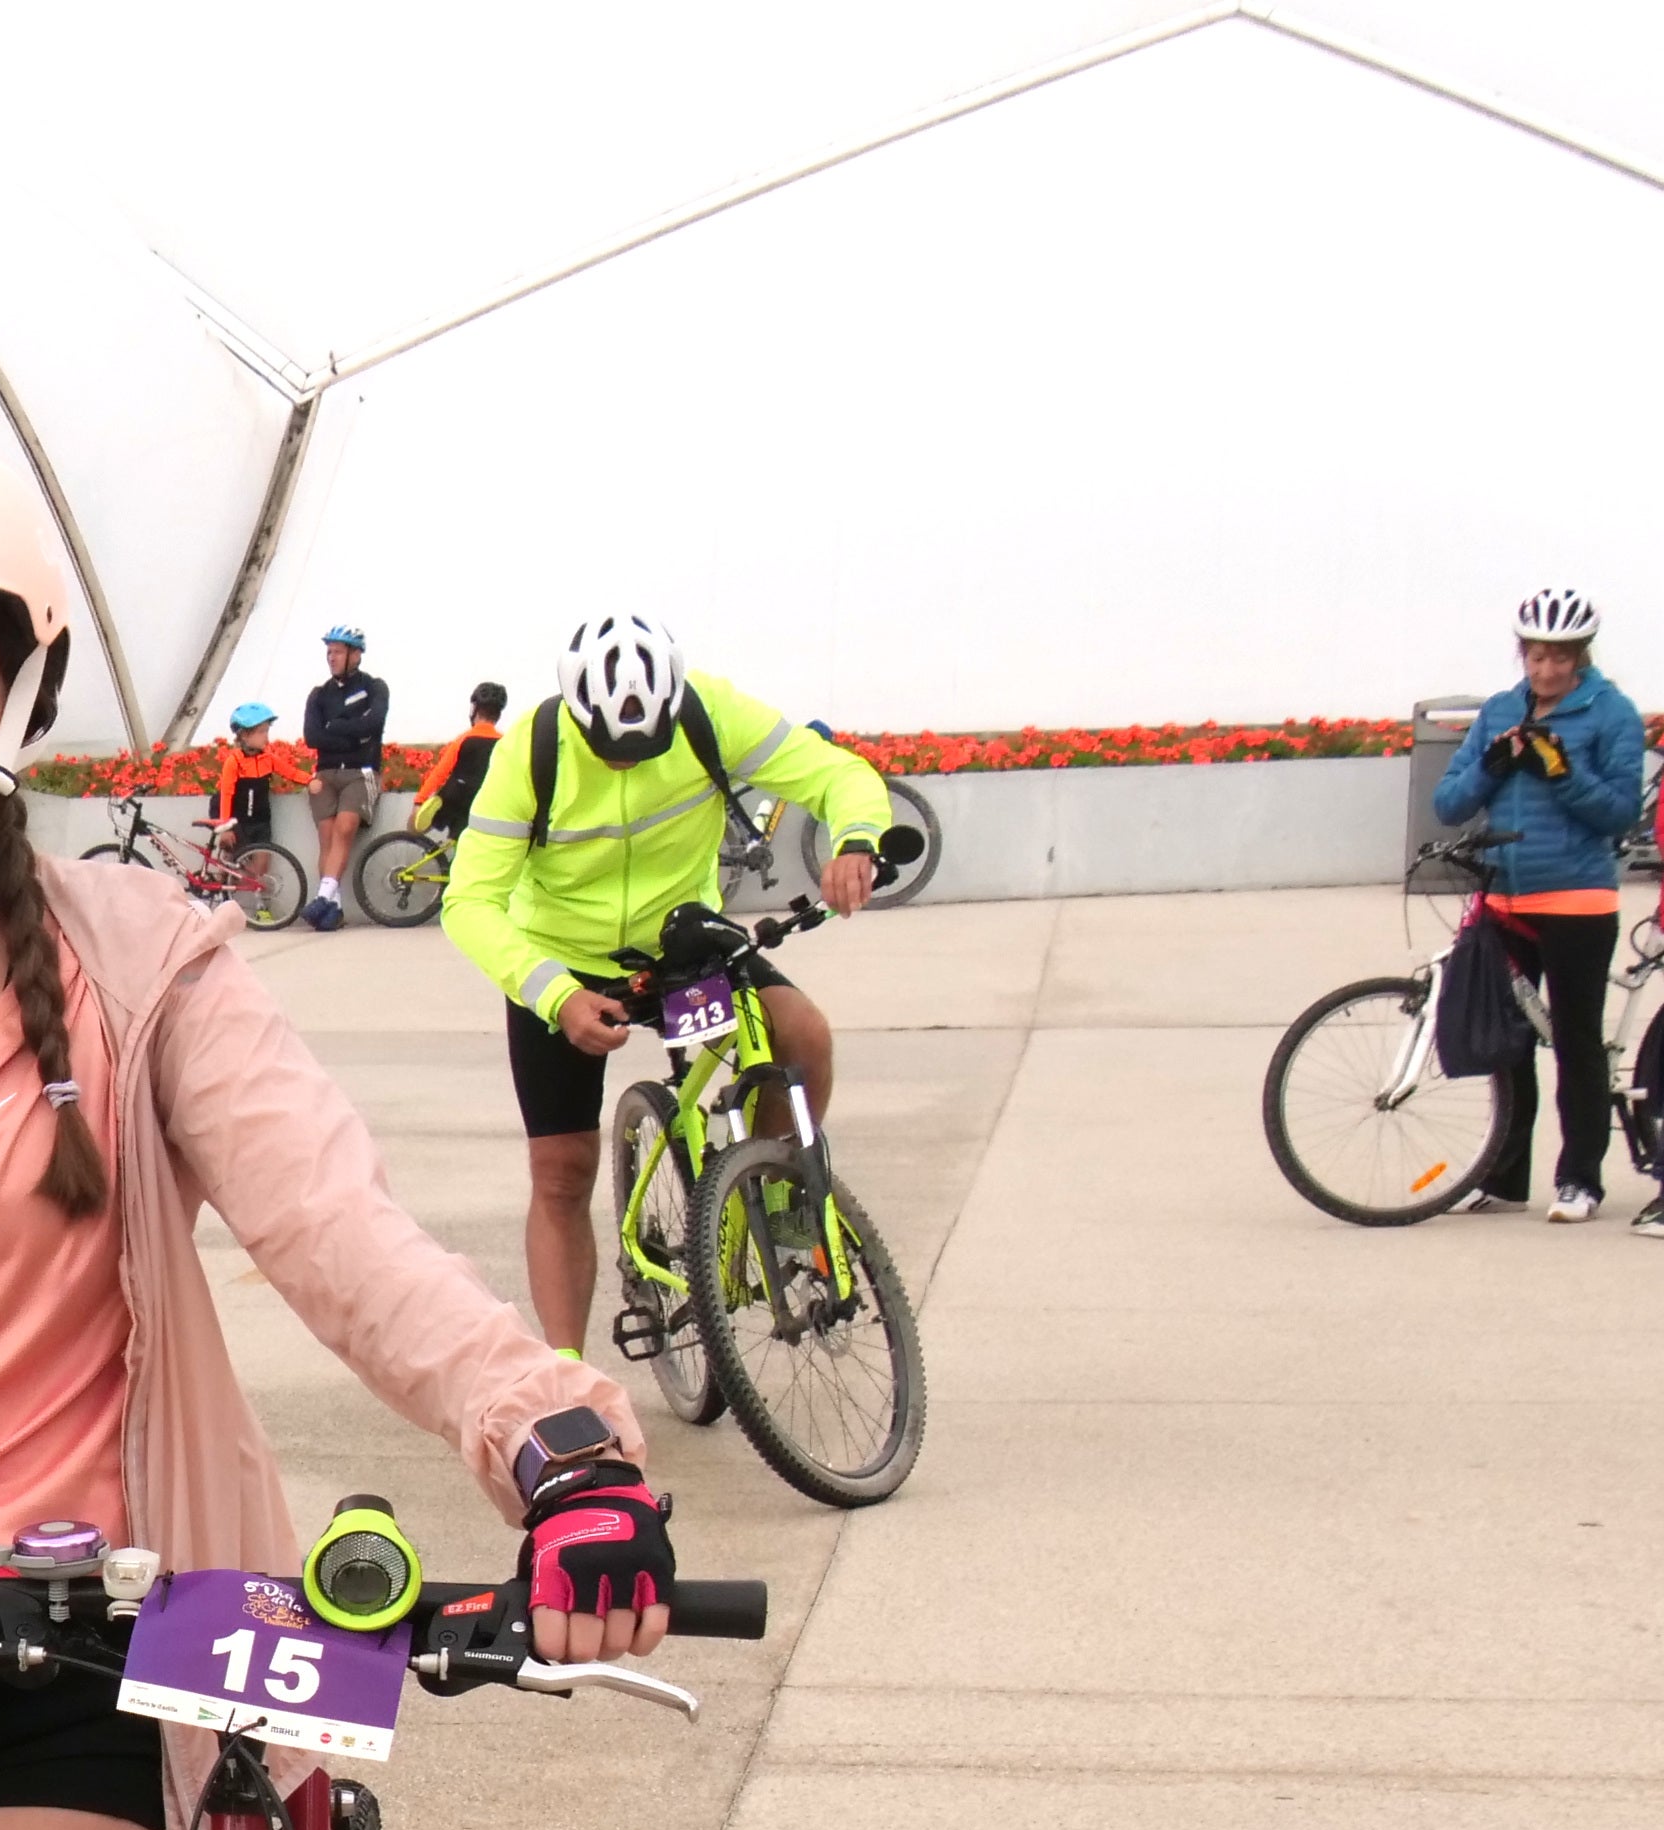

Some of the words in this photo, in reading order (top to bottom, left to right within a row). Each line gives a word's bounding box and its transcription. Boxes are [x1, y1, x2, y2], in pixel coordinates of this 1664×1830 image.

[678, 1001, 725, 1036] 213
[448, 1604, 463, 1614] EZ
[466, 1601, 488, 1612] Fire
[211, 1628, 324, 1704] 15
[464, 1651, 514, 1662] SHIMANO
